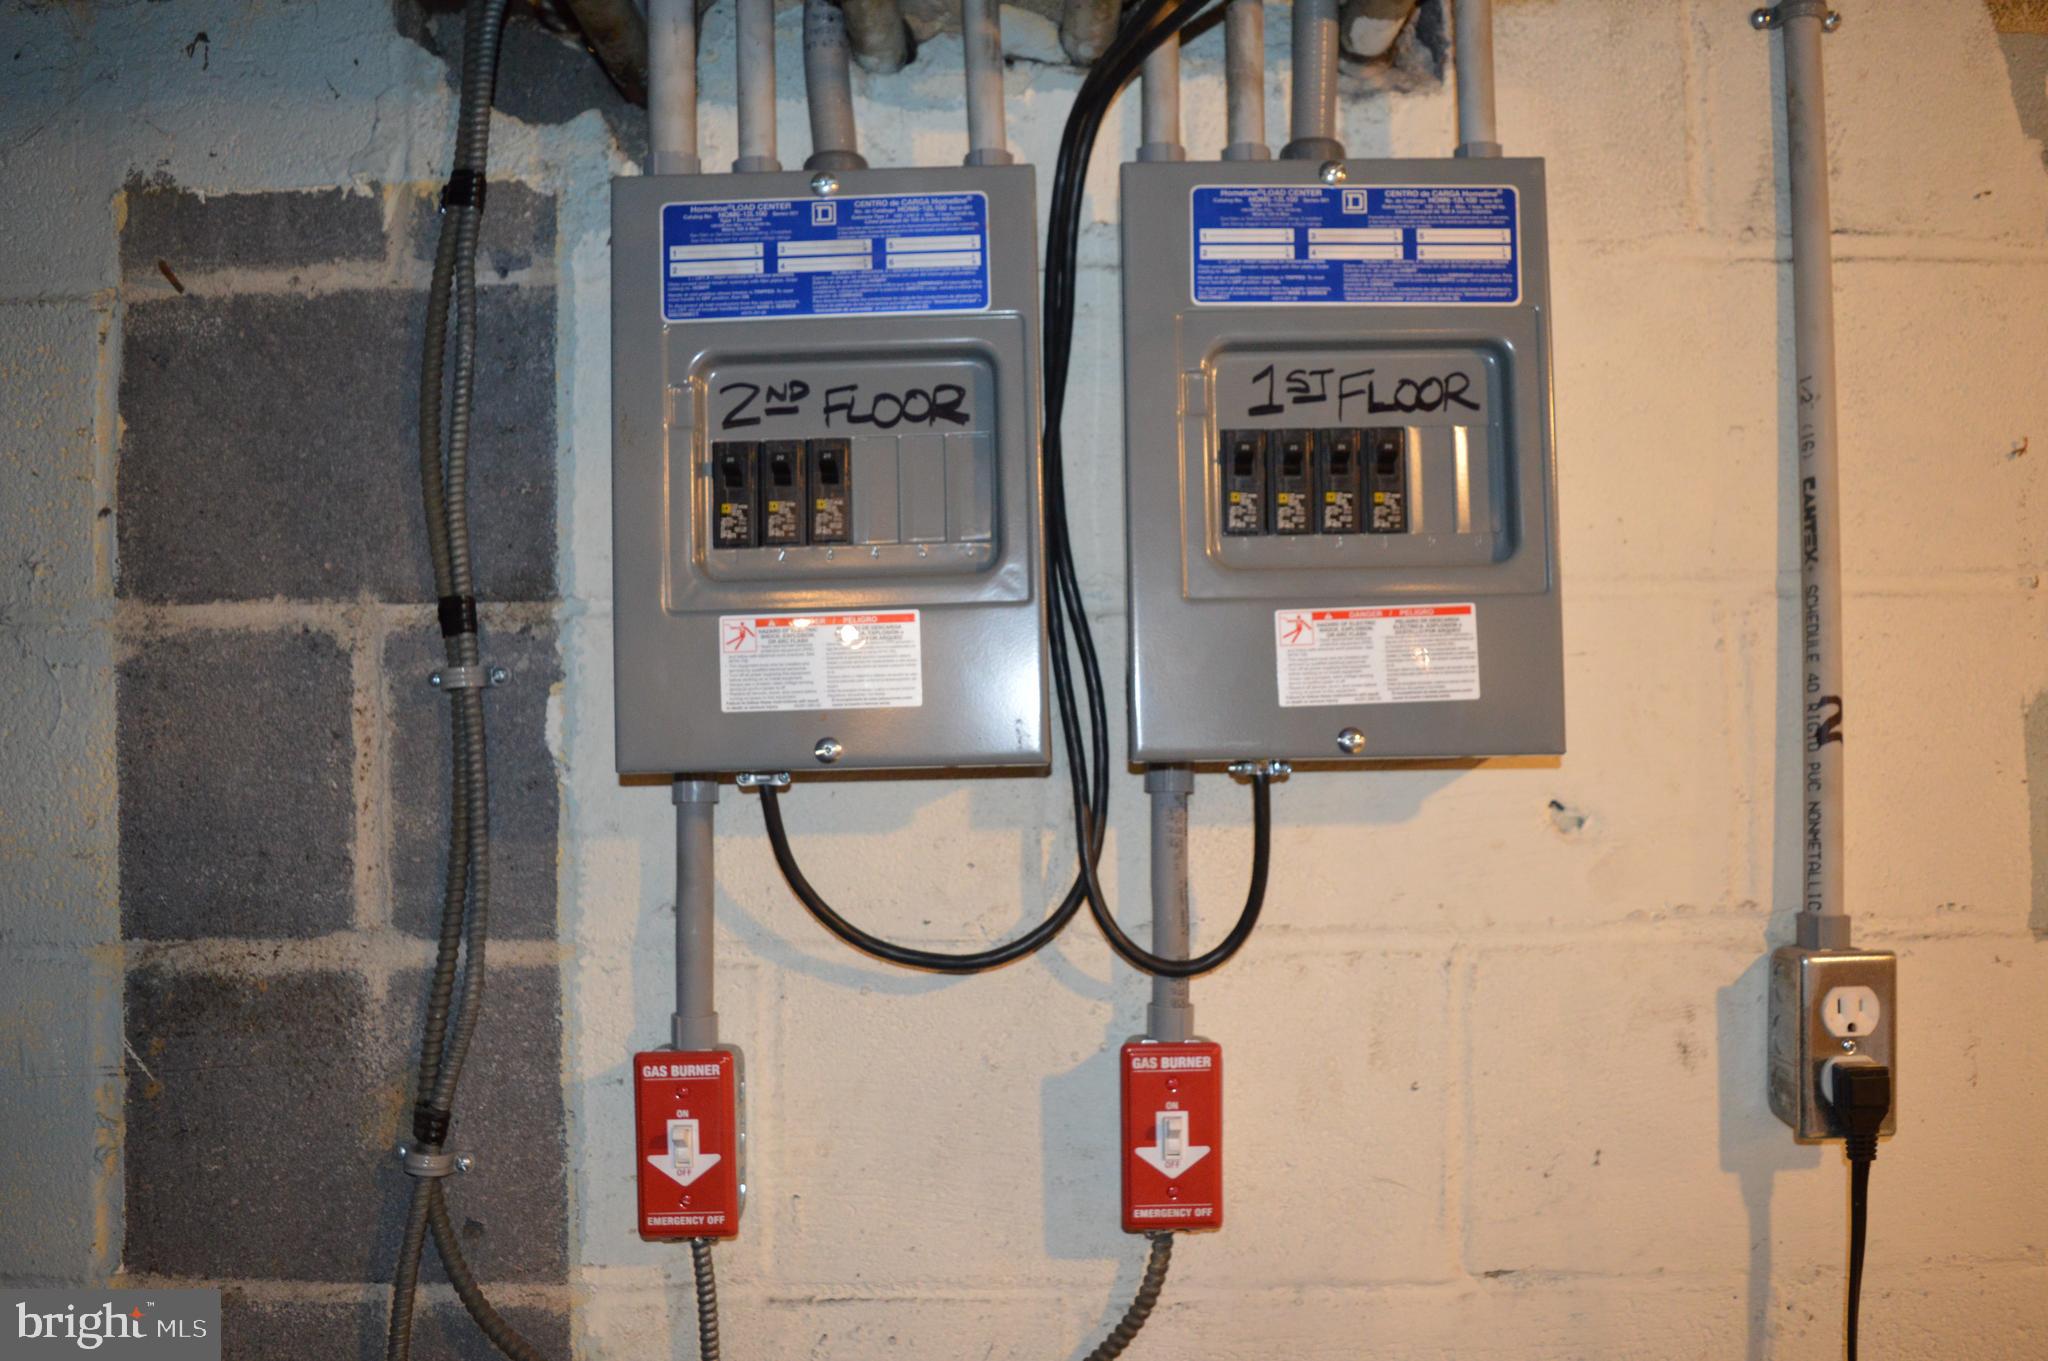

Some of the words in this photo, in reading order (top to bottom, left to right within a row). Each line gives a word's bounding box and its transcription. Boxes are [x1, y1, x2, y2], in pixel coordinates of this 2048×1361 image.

[1431, 189, 1460, 197] CARGA
[732, 202, 756, 211] LOAD
[757, 202, 792, 210] CENTER
[854, 199, 888, 208] CENTRO
[901, 198, 929, 206] CARGA
[1248, 364, 1334, 416] 1ST
[1338, 369, 1480, 422] FLOOR
[719, 380, 809, 430] 2ND
[823, 383, 970, 429] FLOOR
[1803, 476, 1819, 565] CANTEX
[1349, 609, 1382, 619] DANGER
[1399, 607, 1434, 617] PELIGRO
[842, 615, 878, 624] PELIGRO
[1806, 585, 1820, 663] SCHEDULE
[1807, 673, 1821, 693] 40
[1807, 801, 1822, 911] NONMETALLIC
[1132, 1057, 1158, 1070] GAS
[1160, 1056, 1211, 1069] BURNER
[643, 1065, 668, 1078] GAS
[671, 1064, 720, 1077] BURNER
[1165, 1102, 1179, 1110] ON
[676, 1110, 689, 1118] ON
[1164, 1160, 1180, 1168] OFF
[676, 1169, 692, 1177] OFF
[1133, 1208, 1192, 1218] EMERGENCY
[1195, 1207, 1213, 1217] OFF
[647, 1215, 705, 1226] EMERGENCY
[707, 1215, 726, 1225] OFF
